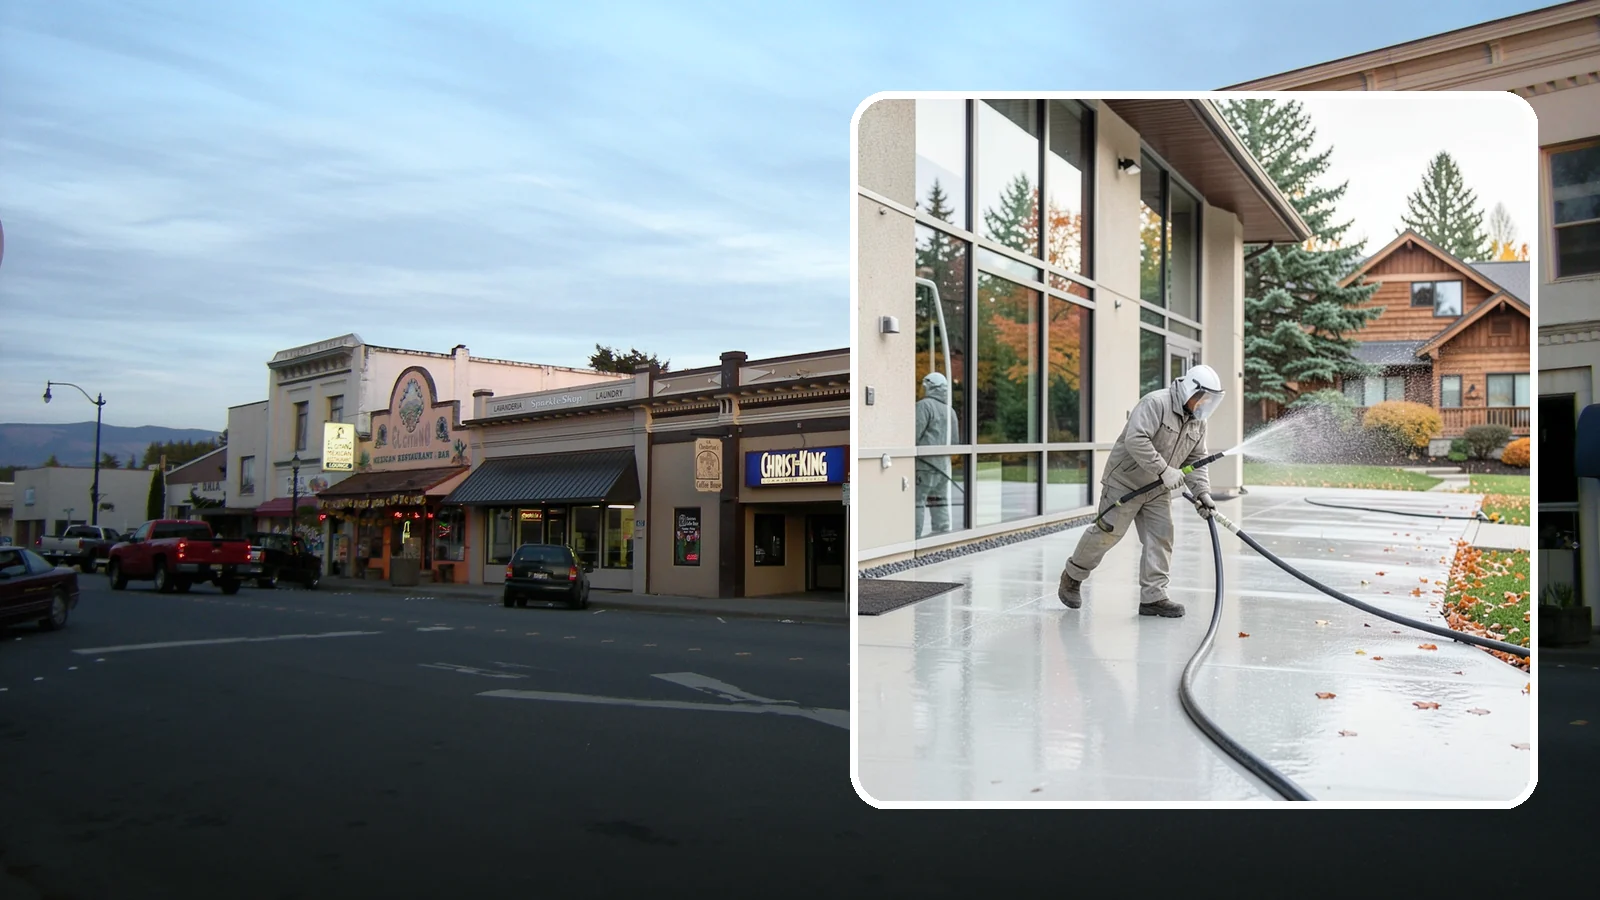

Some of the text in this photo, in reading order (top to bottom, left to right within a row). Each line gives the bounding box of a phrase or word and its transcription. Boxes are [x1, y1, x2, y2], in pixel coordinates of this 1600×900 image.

[562, 394, 583, 405] Shop
[595, 389, 624, 400] LAUNDRY
[493, 403, 523, 413] LAVANDERIA
[398, 452, 433, 462] RESTAURANT
[437, 450, 450, 459] BAR
[761, 450, 827, 478] CHRIST KING
